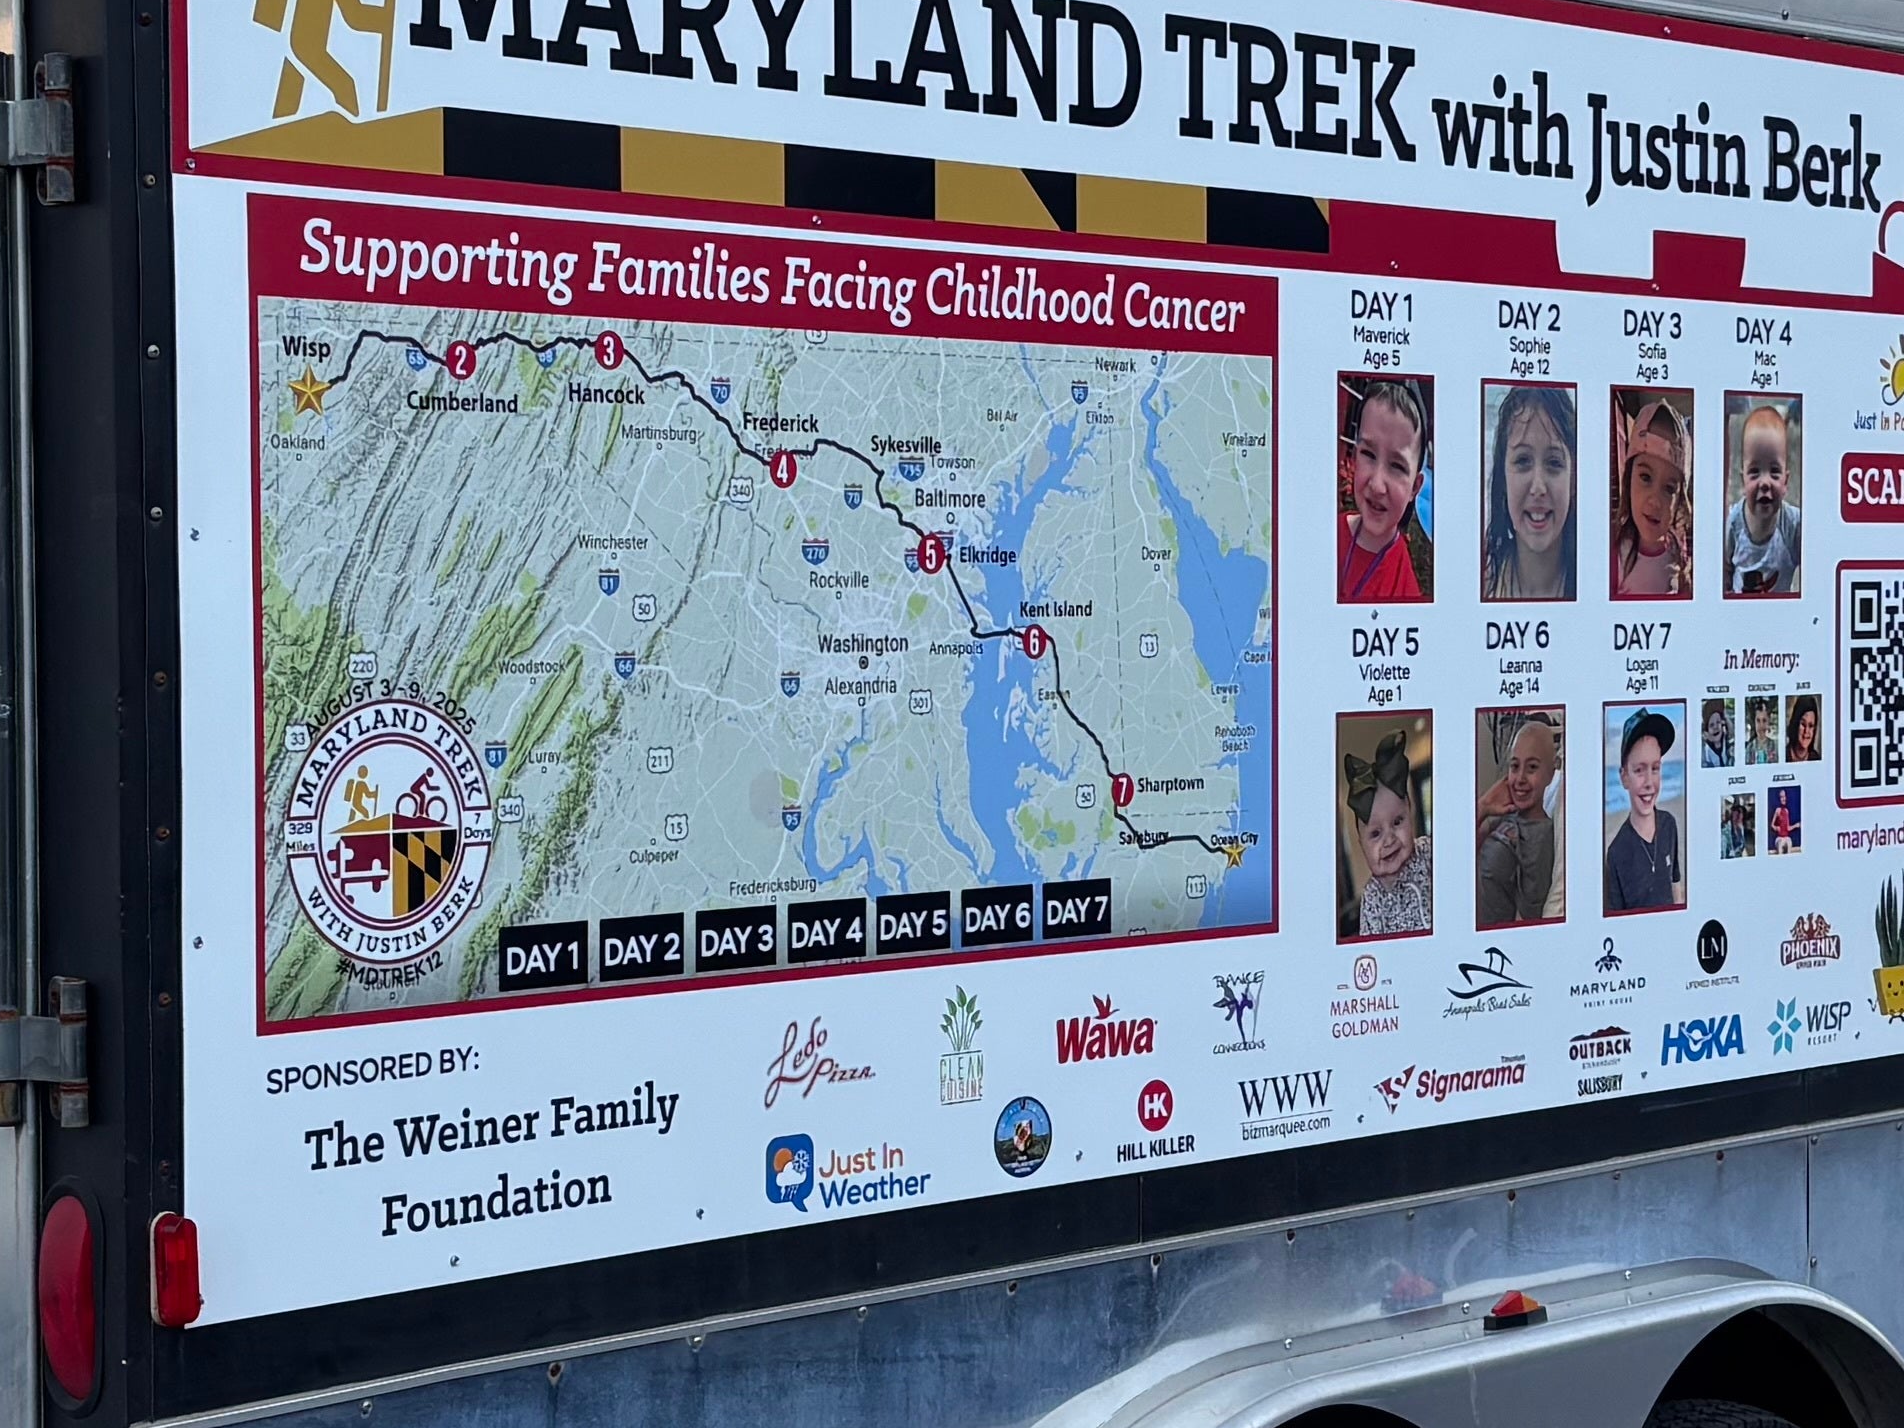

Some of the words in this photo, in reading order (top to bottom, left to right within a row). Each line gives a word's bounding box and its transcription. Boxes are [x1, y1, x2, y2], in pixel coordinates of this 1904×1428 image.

[1164, 13, 1417, 163] TREK
[1431, 71, 1573, 180] with
[1586, 91, 1751, 206] Justin
[1762, 114, 1881, 214] Berk
[300, 217, 576, 306] Supporting
[588, 242, 771, 306] Families
[781, 256, 916, 327] Facing
[926, 262, 1114, 326] Childhood
[1124, 281, 1245, 332] Cancer
[1352, 290, 1398, 321] DAY
[1404, 293, 1412, 322] 1
[1499, 301, 1542, 330] DAY
[1548, 304, 1560, 331] 2
[1354, 326, 1409, 345] Maverick
[1624, 310, 1665, 339] DAY
[1670, 313, 1682, 339] 3
[1736, 317, 1775, 345] DAY
[1779, 321, 1792, 346] 4
[282, 336, 331, 362] Wisp
[1510, 337, 1551, 356] Sophie
[1639, 343, 1667, 359] Sofia
[1755, 351, 1776, 366] Mac
[407, 391, 518, 413] Cumberland
[570, 383, 644, 405] Hancock
[743, 413, 819, 433] Frederick
[1853, 410, 1876, 430] Just
[1880, 412, 1890, 430] In
[271, 434, 325, 451] Oakland
[622, 426, 696, 445] Martinsburg
[871, 435, 941, 453] Sykesville
[929, 455, 975, 469] Towson
[915, 490, 986, 507] Baltimore
[577, 534, 648, 549] Winchester
[959, 547, 1016, 566] Elkridge
[809, 572, 869, 588] Rockville
[1020, 602, 1049, 617] Kent
[1054, 601, 1092, 617] Island
[818, 634, 908, 655] Washington
[1353, 628, 1399, 657] DAY
[1405, 627, 1419, 656] 5
[1486, 621, 1529, 649] DAY
[1535, 621, 1550, 648] 6
[1614, 623, 1654, 650] DAY
[1660, 623, 1671, 649] 7
[499, 660, 566, 673] Woodstock
[1359, 664, 1410, 681] Violette
[1627, 657, 1658, 675] Logan
[825, 678, 896, 694] Alexandria
[297, 708, 427, 808] MARYLAND
[437, 725, 482, 801] TREK
[1138, 778, 1204, 794] Sharptown
[730, 877, 816, 895] Fredericksburg
[308, 886, 353, 942] WITH
[359, 930, 427, 953] JUSTIN
[435, 877, 474, 934] BERK
[966, 904, 1011, 933] DAY
[1016, 902, 1031, 928] 6
[1047, 897, 1091, 926] DAY
[1095, 896, 1108, 922] 7
[792, 918, 841, 948] DAY
[846, 917, 863, 943] 4
[880, 911, 927, 941] DAY
[932, 909, 946, 935] 5
[605, 934, 658, 967] DAY
[664, 933, 680, 961] 2
[701, 926, 751, 957] DAY
[758, 925, 774, 952] 3
[1783, 937, 1838, 963] PHOENIX
[507, 943, 562, 976] DAY
[568, 942, 579, 969] 1
[1570, 977, 1646, 997] MARYLAND
[1330, 995, 1399, 1017] MARSHALL
[1806, 1002, 1851, 1032] WISP
[1056, 1017, 1155, 1064] Wawa
[1332, 1017, 1399, 1038] GOLDMAN
[1661, 1014, 1744, 1065] HOKA
[1569, 1039, 1631, 1060] OUTBACK
[266, 1053, 431, 1094] SPONSORED
[440, 1046, 479, 1073] BY:
[1416, 1063, 1525, 1102] Signarama
[305, 1120, 384, 1170] The
[393, 1108, 540, 1157] Weiner
[550, 1081, 679, 1137] Family
[1242, 1116, 1330, 1141] bizmarquee.com
[819, 1148, 876, 1178] Just
[882, 1142, 903, 1168] In
[1117, 1143, 1147, 1163] HILL
[1150, 1135, 1194, 1157] KILLER
[819, 1172, 930, 1208] Weather
[382, 1170, 612, 1237] Foundation
